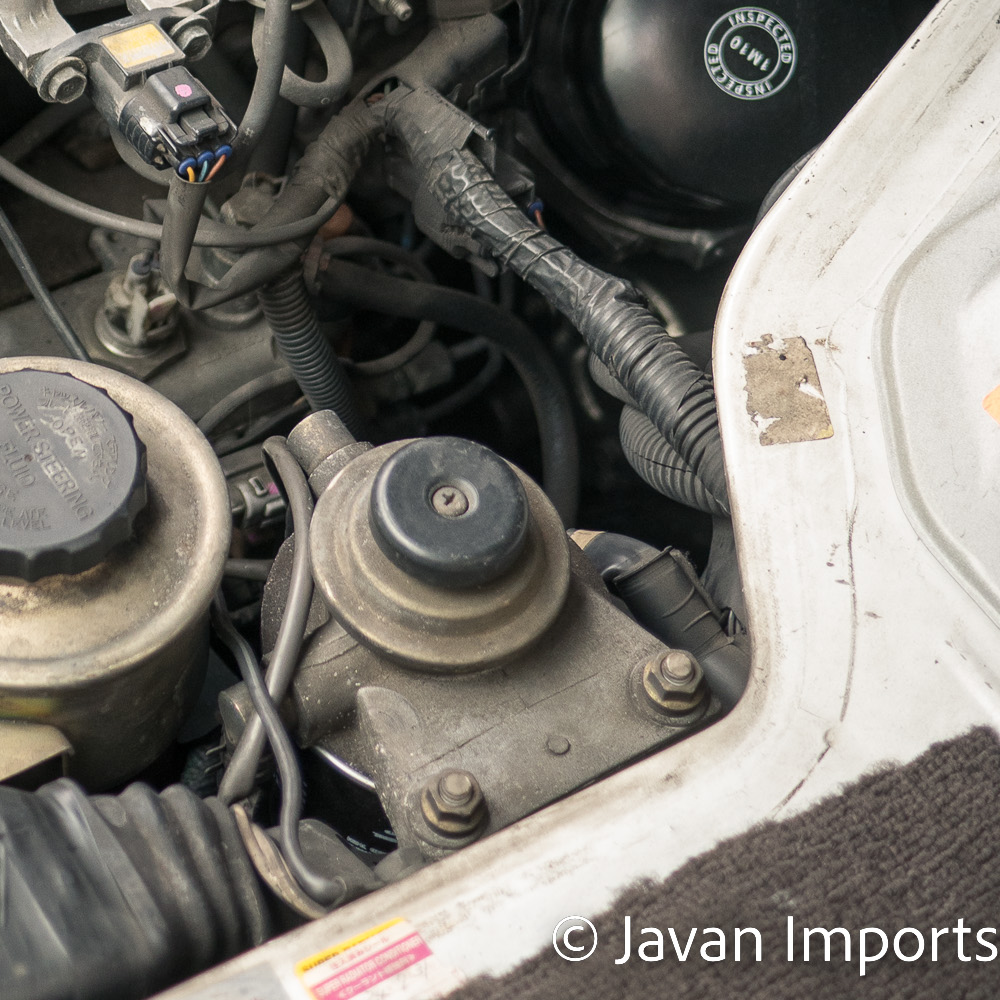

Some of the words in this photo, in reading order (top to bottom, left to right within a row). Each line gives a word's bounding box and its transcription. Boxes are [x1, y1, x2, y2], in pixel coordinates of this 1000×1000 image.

[728, 12, 793, 64] INSPECTED
[707, 43, 774, 97] INSPECTED
[52, 419, 88, 459] OPEN
[33, 439, 95, 521] STEERING
